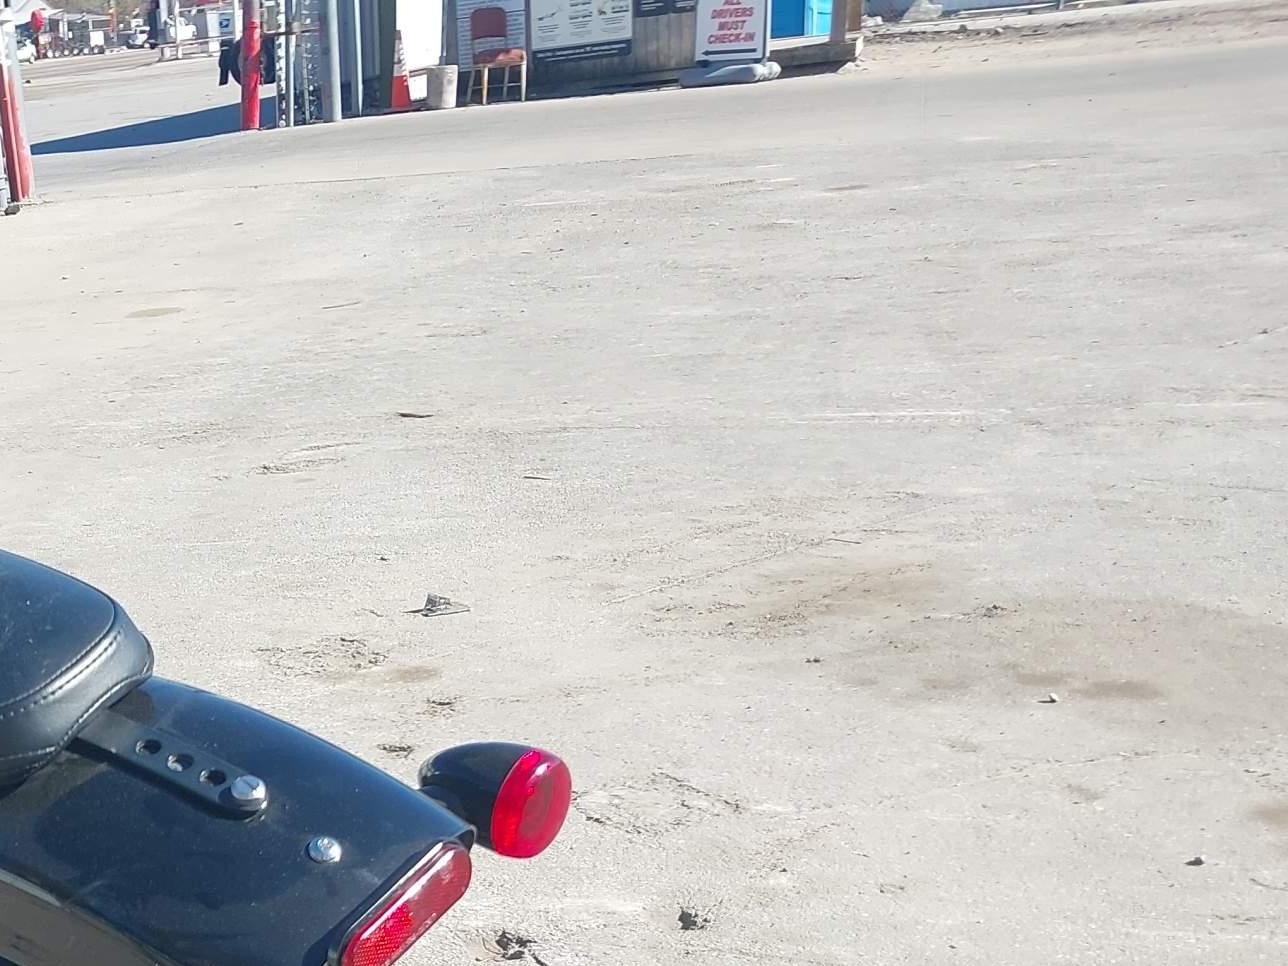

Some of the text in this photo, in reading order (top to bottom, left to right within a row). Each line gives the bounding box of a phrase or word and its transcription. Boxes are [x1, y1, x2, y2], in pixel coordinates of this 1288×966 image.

[711, 7, 754, 19] DRIVERS
[718, 20, 746, 31] MUST
[707, 32, 756, 44] CHECK-IN
